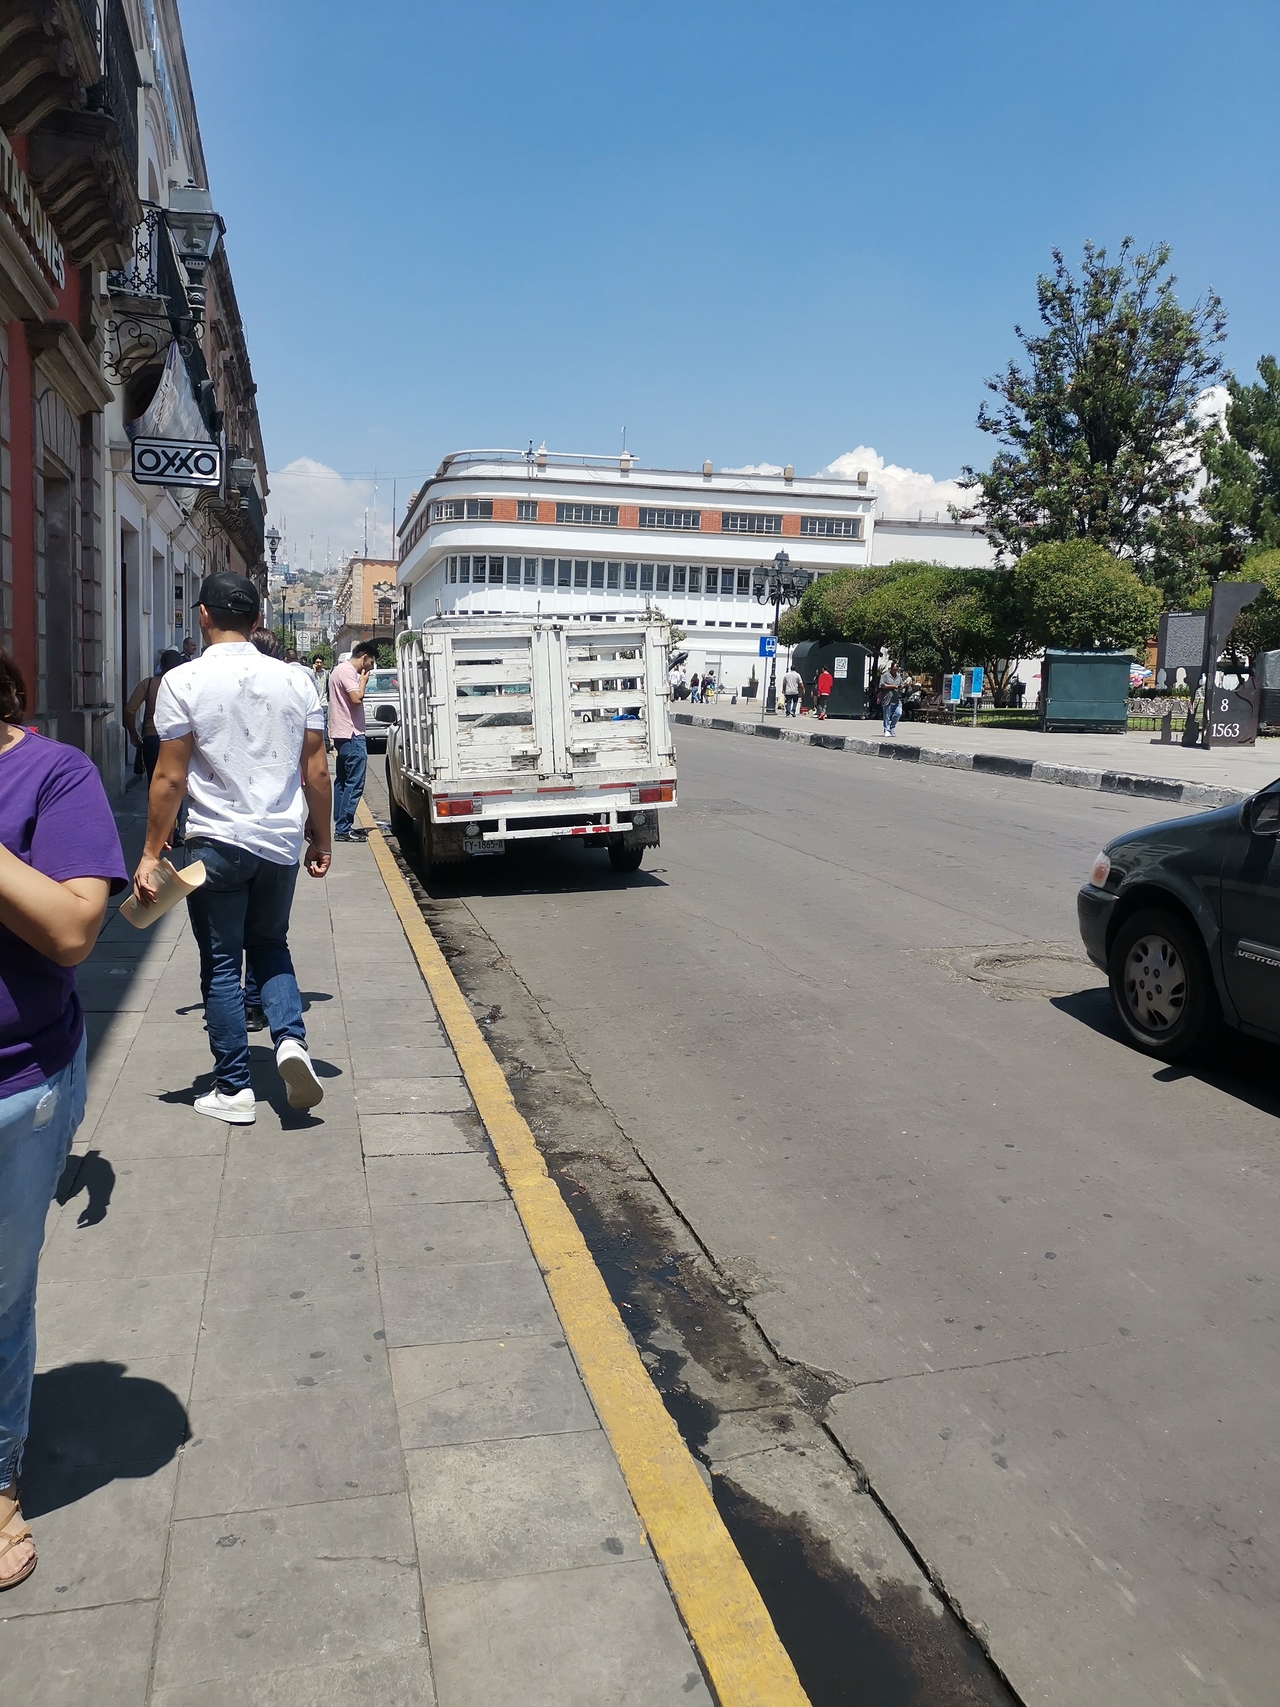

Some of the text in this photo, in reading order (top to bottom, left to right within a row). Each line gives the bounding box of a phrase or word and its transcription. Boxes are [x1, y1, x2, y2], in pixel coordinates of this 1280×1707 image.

[0, 126, 66, 290] TACIONES
[137, 447, 217, 476] OXXO
[1220, 698, 1229, 712] 8
[1211, 723, 1240, 738] 1563
